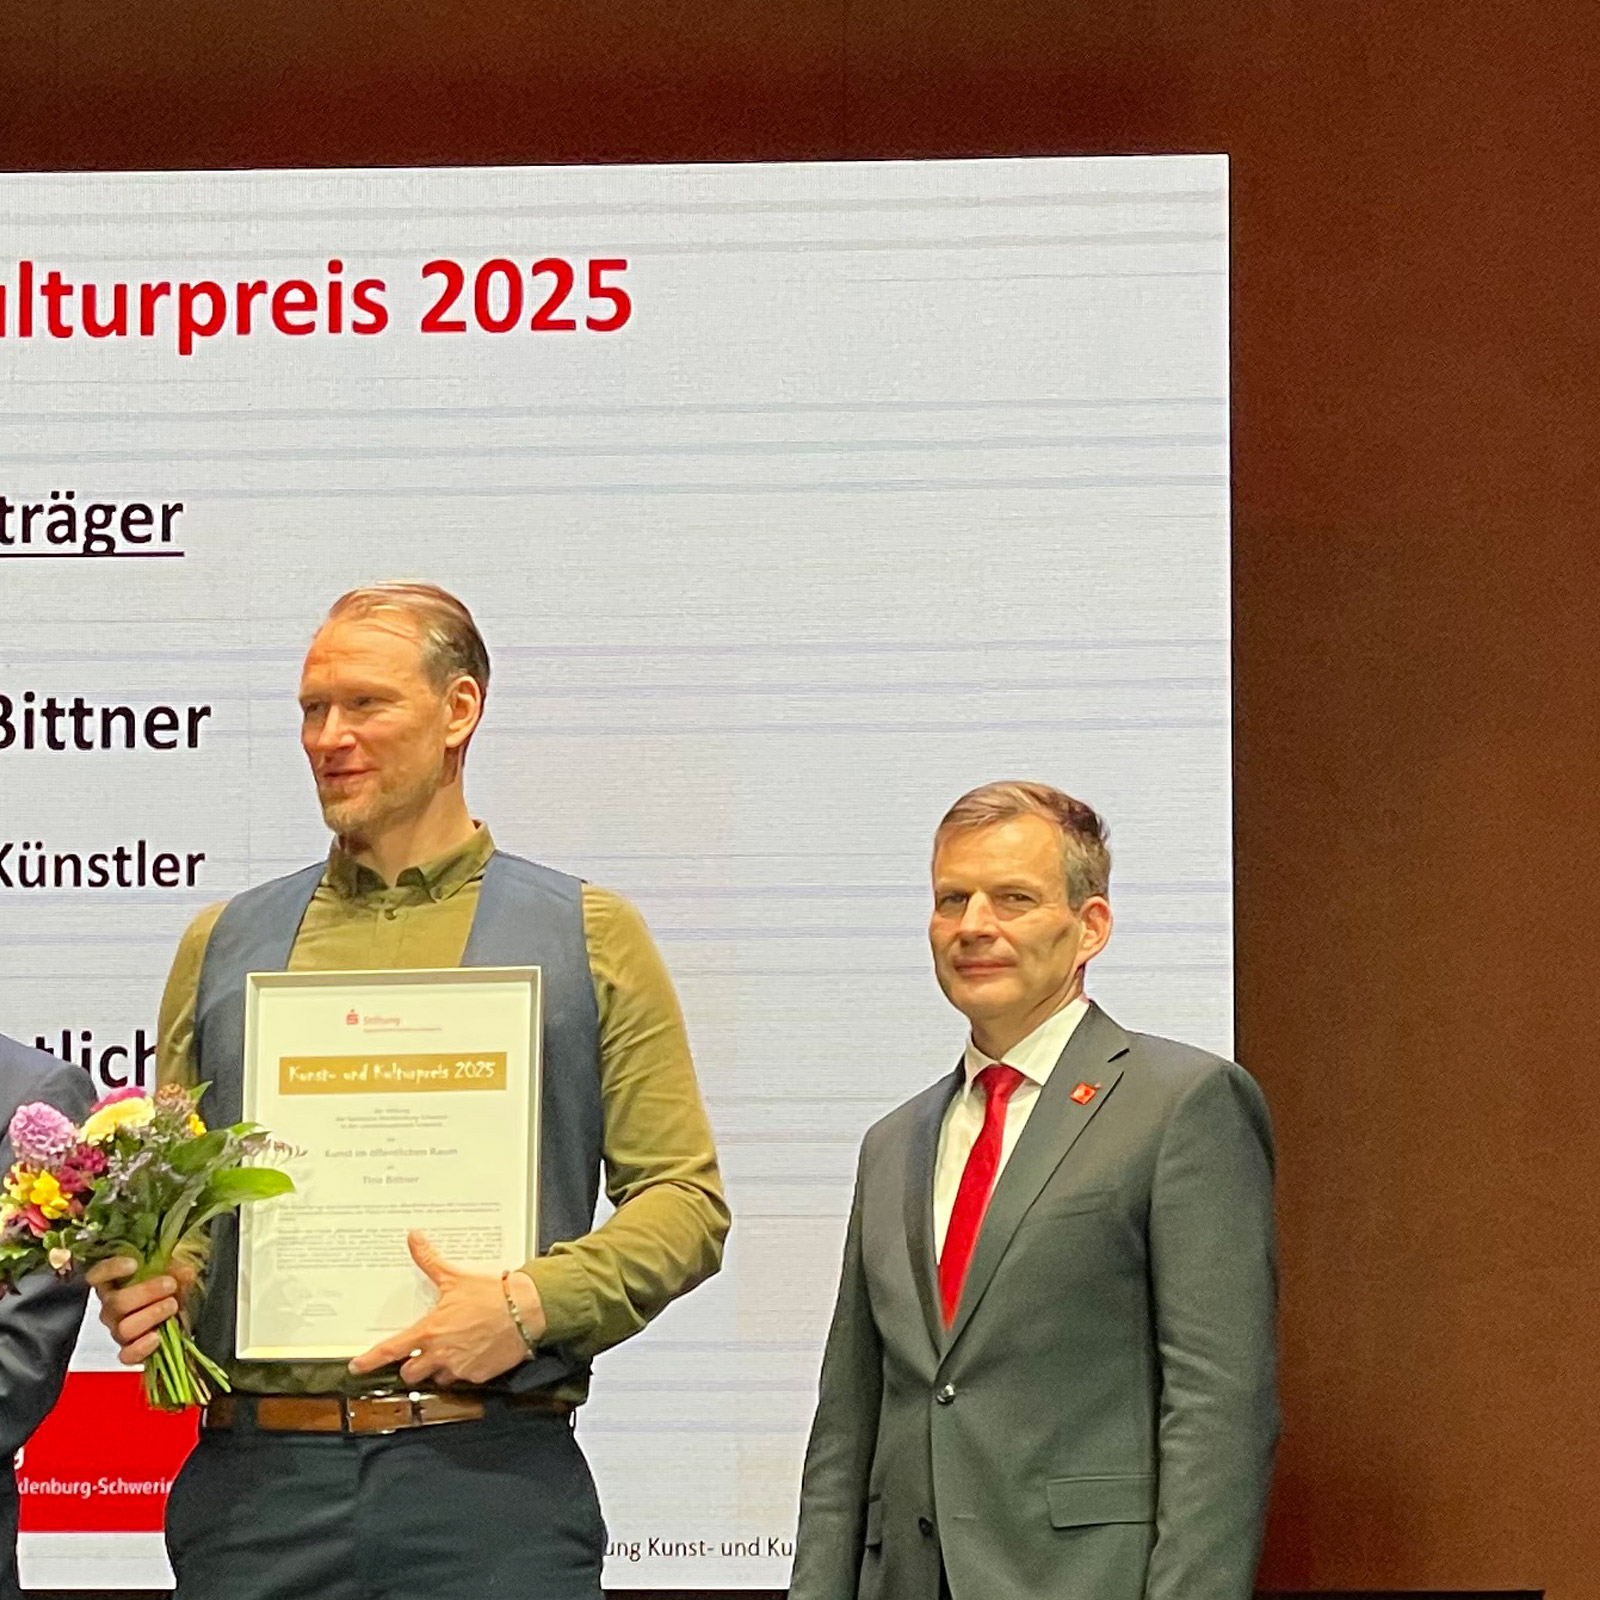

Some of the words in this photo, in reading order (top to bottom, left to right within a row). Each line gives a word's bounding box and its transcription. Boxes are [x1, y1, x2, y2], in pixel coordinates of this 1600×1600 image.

[420, 257, 632, 333] 2025
[454, 1061, 496, 1079] 2025
[648, 1537, 714, 1557] Kunst-
[721, 1536, 760, 1557] und
